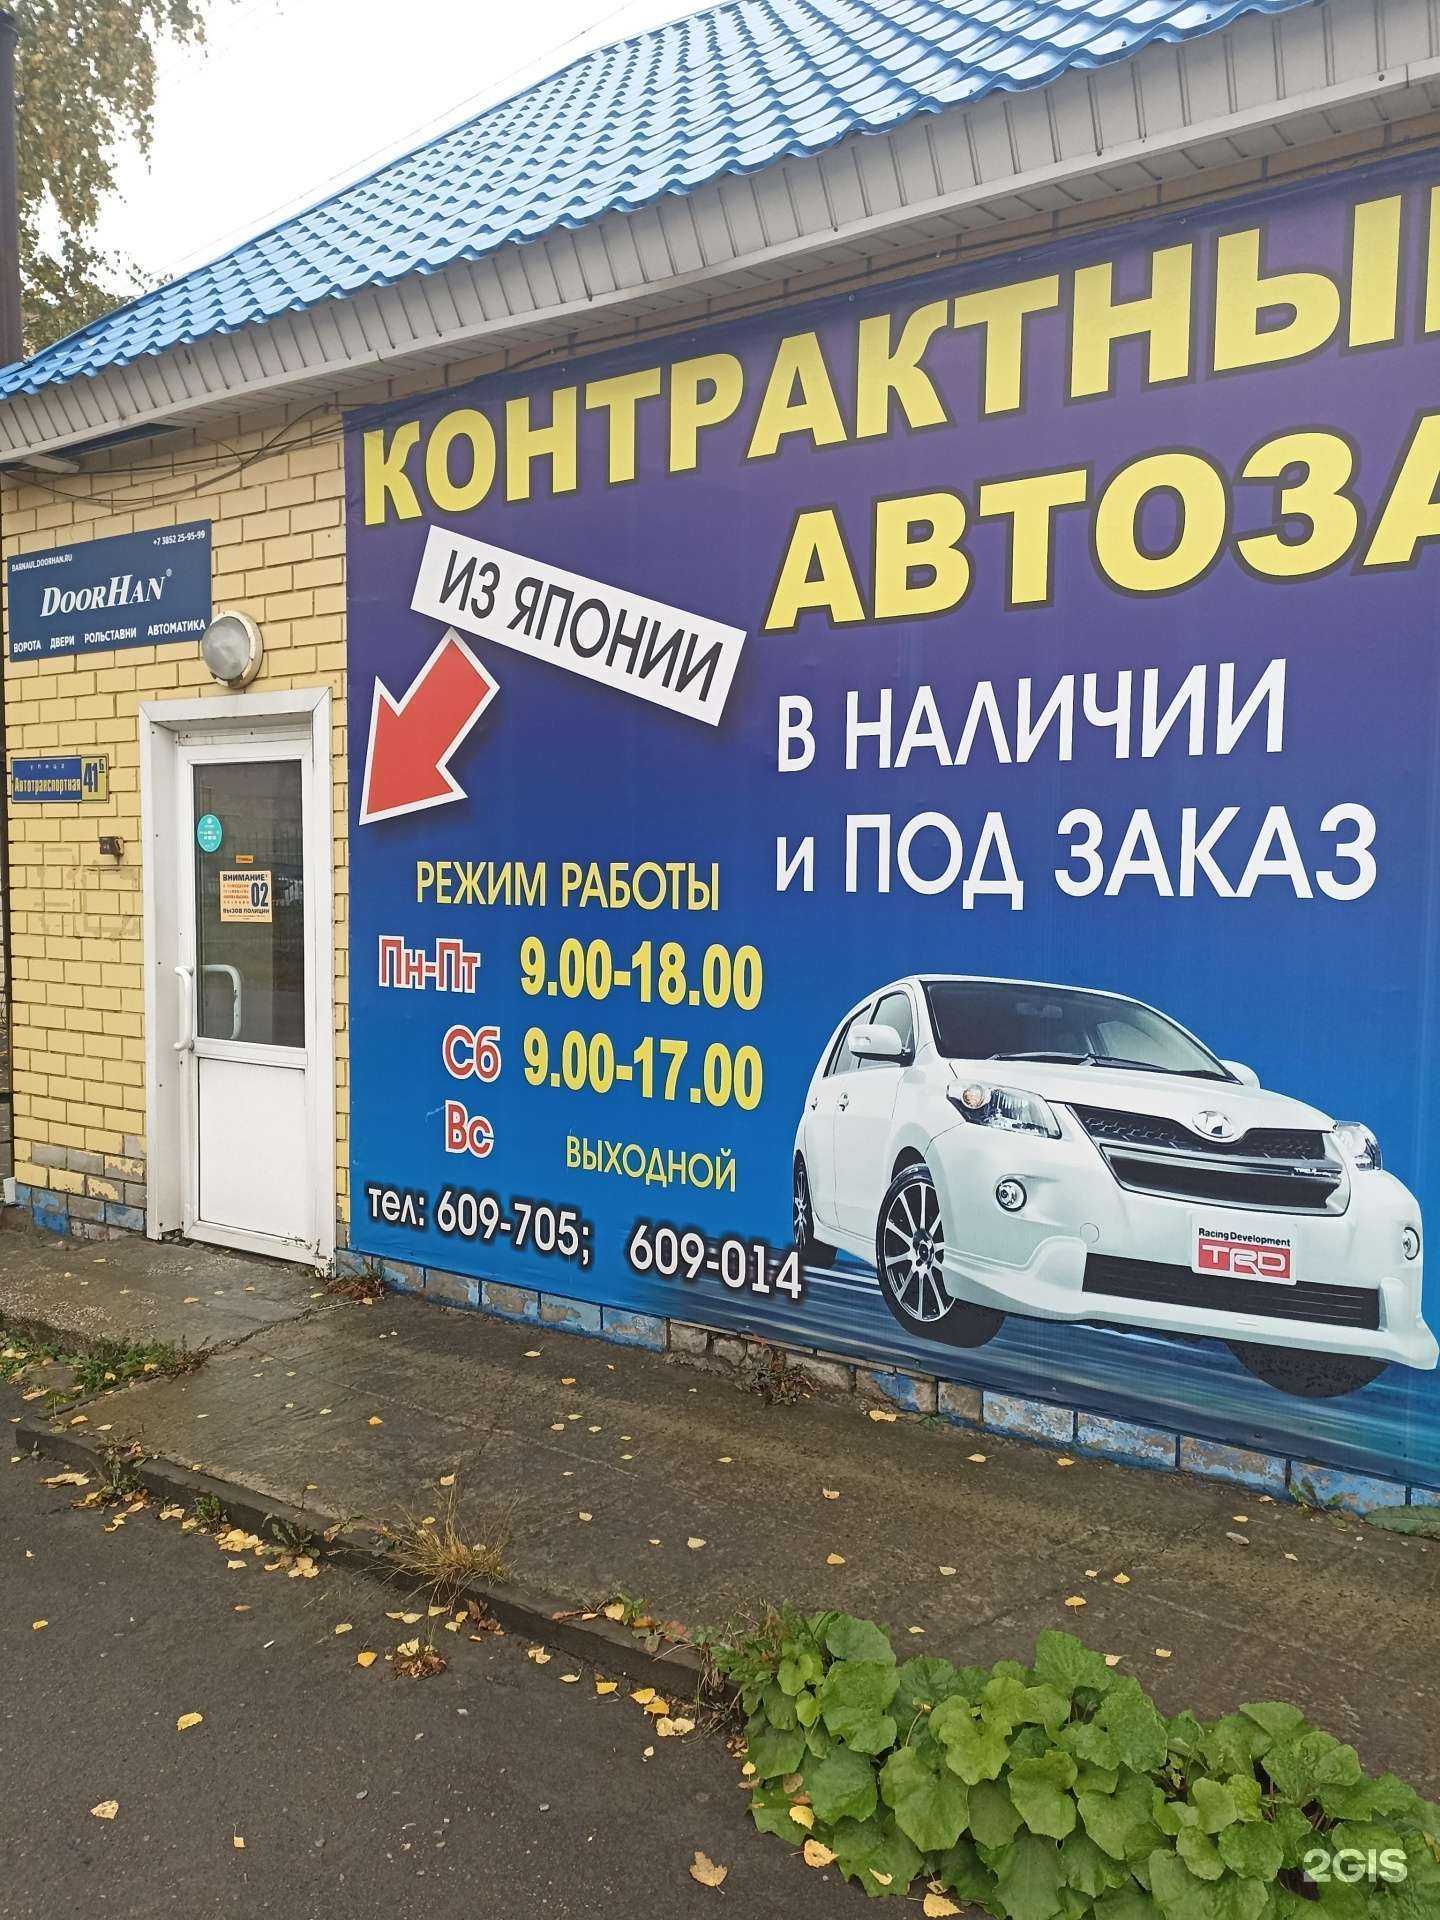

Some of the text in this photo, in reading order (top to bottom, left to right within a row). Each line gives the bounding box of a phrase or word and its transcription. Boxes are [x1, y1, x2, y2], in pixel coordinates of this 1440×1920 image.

[362, 184, 1440, 526] КОНТРАКТНЫ
[161, 534, 176, 545] 3852
[13, 618, 206, 653] ВОРОТА ДВЕРИ РОЛЬСТАВНИ АВТОМАТИКА
[438, 550, 724, 703] ИЗ ЯПОНИИ
[777, 658, 1287, 773] В НАЛИЧИИ
[250, 882, 269, 907] 02
[416, 861, 720, 911] РЕЖИМ РАБОТЫ
[845, 811, 1024, 911] ПОД
[1054, 803, 1377, 901] ЗАКАЗ
[378, 934, 764, 1011] Пн-Пт 9.00-18.00
[442, 1024, 764, 1111] Сб 9.00-17.00
[444, 1100, 737, 1192] Вс ВЫХОДНОЙ
[368, 1187, 803, 1299] тел: 609-705; 609-014
[1198, 1227, 1291, 1248] Racing Development
